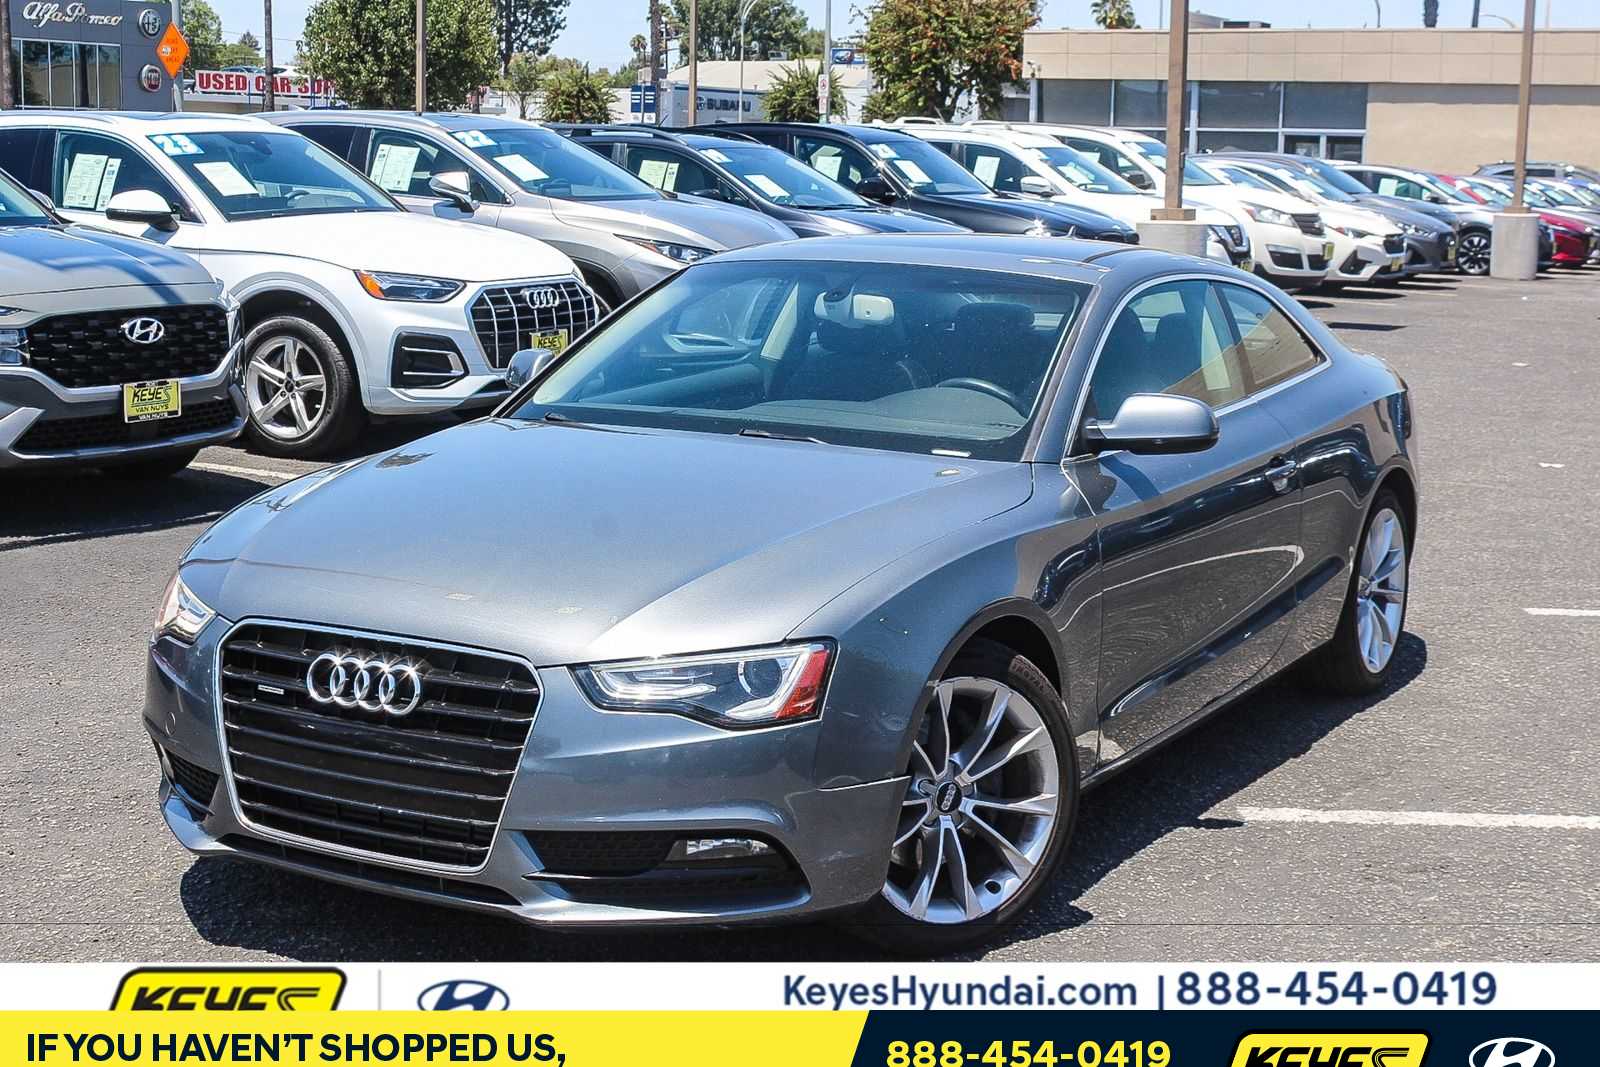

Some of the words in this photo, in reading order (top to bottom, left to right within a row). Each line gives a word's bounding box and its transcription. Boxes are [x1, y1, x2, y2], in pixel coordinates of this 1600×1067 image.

[22, 1, 64, 28] Alfa
[66, 2, 123, 26] Romeo
[198, 72, 247, 91] USED
[131, 385, 173, 405] KEYES
